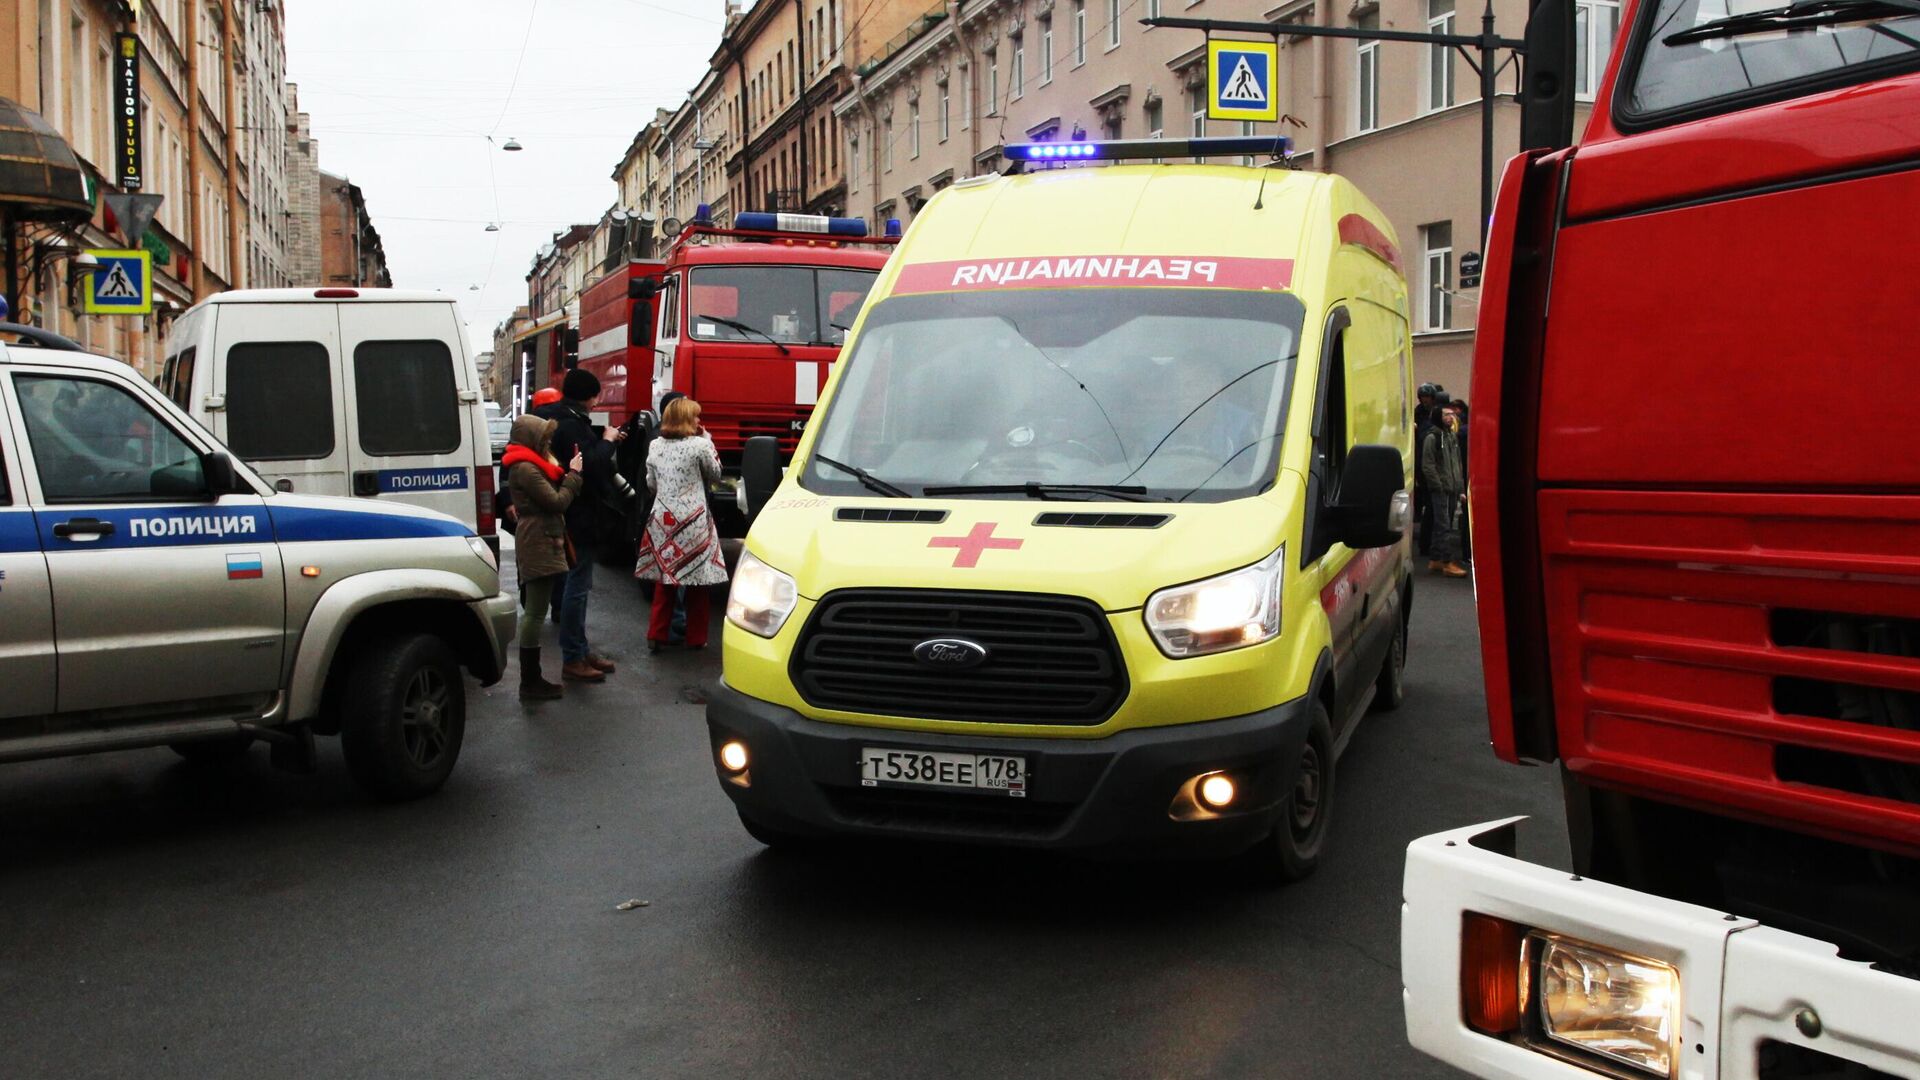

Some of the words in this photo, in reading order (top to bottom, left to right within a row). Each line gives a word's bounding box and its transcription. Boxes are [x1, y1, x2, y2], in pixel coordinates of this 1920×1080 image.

[125, 59, 135, 116] TATTOO
[127, 119, 136, 175] STUDIO
[392, 473, 461, 489] ПОЛИЦИЯ
[130, 515, 256, 537] ПОЛИЦИЯ
[928, 643, 968, 661] Ford
[978, 757, 1018, 780] 178
[986, 779, 1008, 788] RUS
